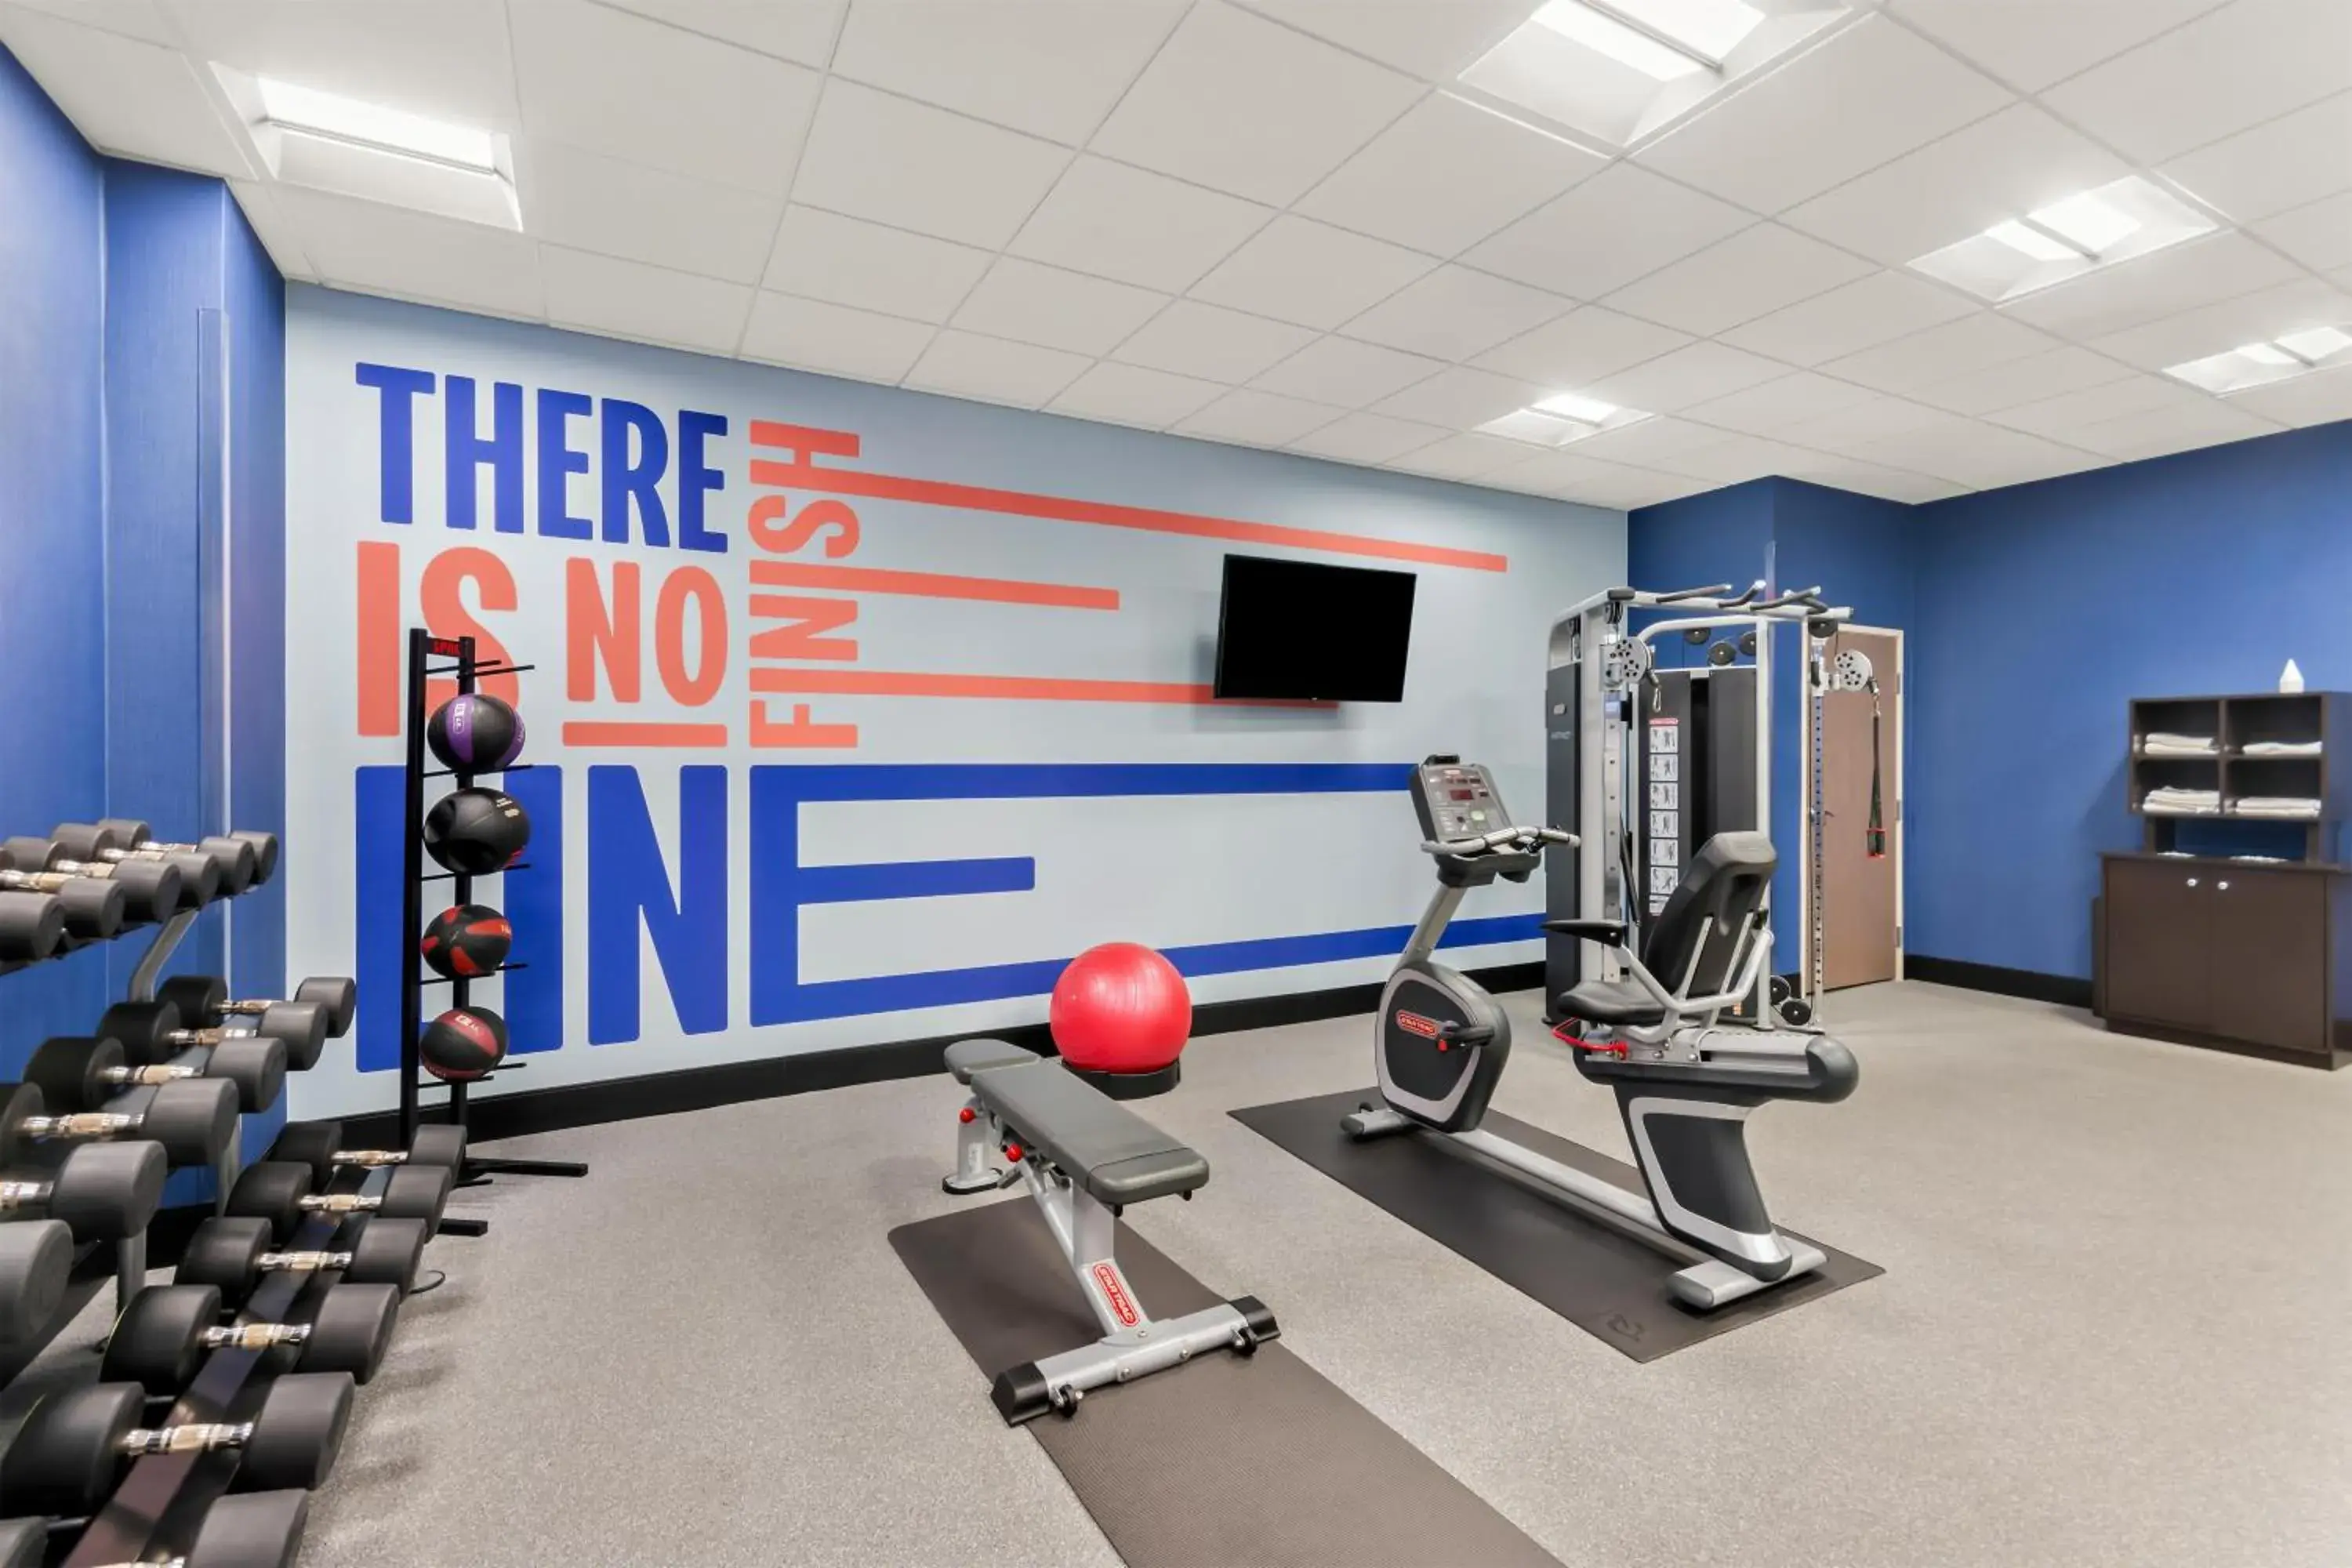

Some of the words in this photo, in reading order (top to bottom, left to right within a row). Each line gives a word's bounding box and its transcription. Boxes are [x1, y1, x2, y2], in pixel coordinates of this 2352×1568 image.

[355, 362, 728, 554] THERE
[357, 540, 519, 737] IS
[565, 557, 728, 707] NO
[747, 419, 860, 749] FINISH
[1099, 1269, 1119, 1293] STAR
[1112, 1292, 1136, 1321] TRAC
